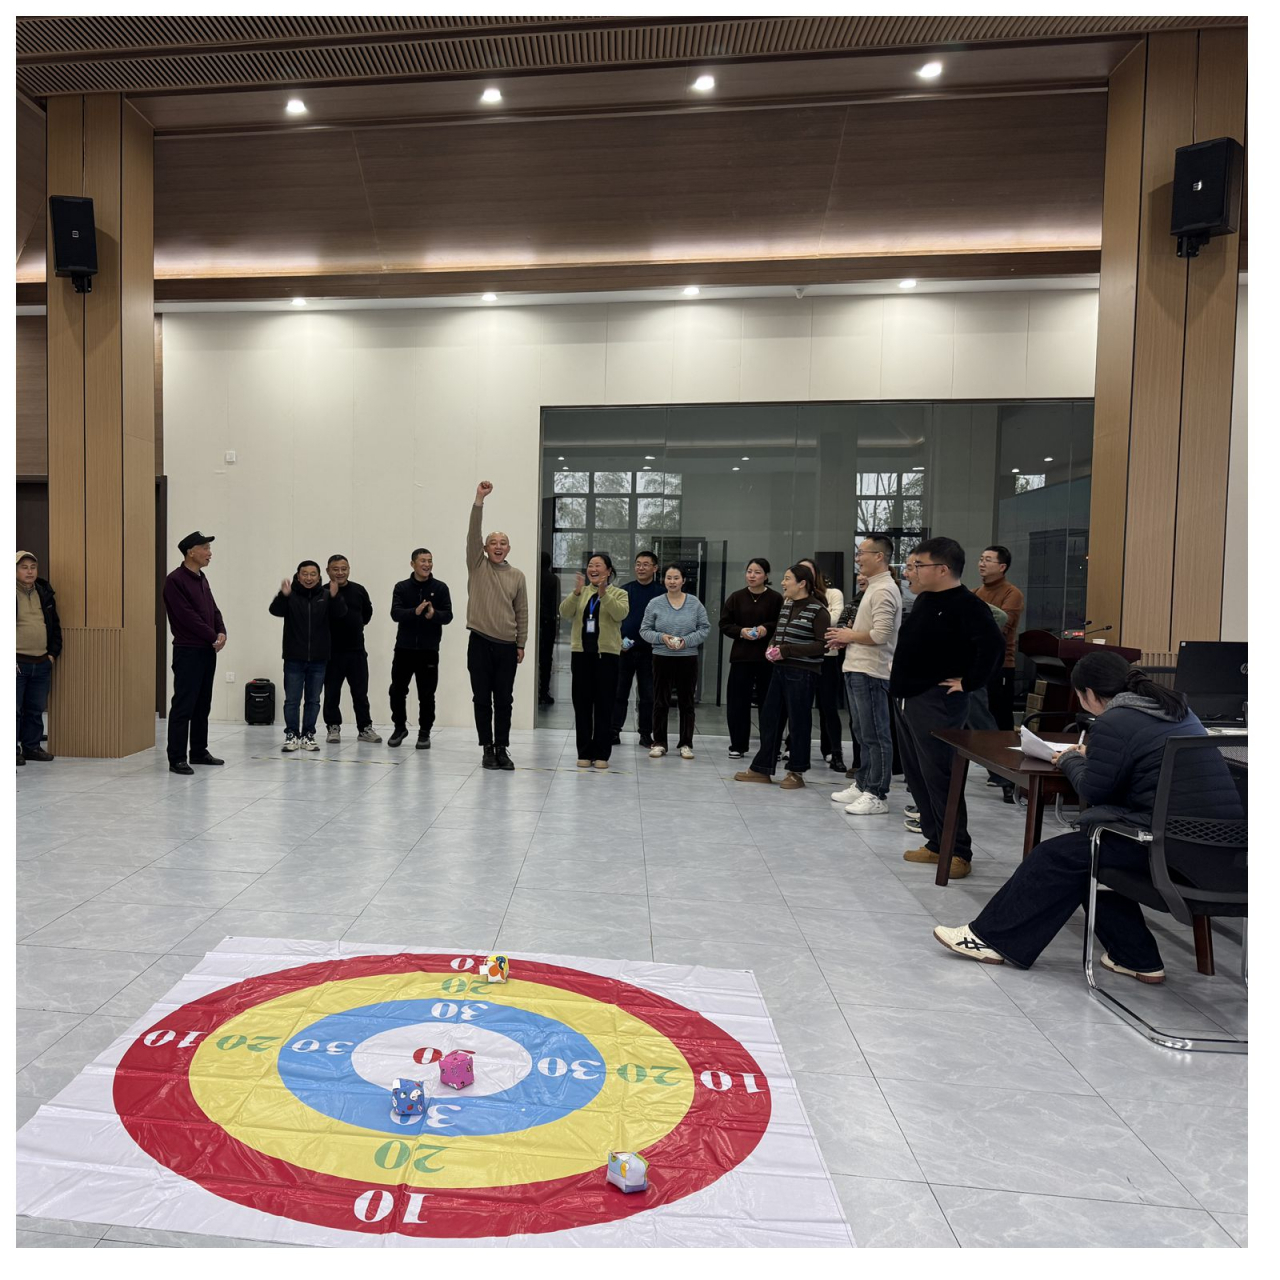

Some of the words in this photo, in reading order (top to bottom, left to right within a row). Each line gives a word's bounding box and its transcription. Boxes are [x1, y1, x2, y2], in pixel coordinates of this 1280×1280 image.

[450, 957, 475, 971] 0
[442, 977, 493, 995] 20
[431, 1002, 489, 1021] 30
[143, 1029, 208, 1049] 10
[216, 1034, 282, 1053] 20
[291, 1038, 354, 1055] 30
[537, 1057, 601, 1080] 30
[616, 1062, 682, 1087] 20
[700, 1070, 766, 1094] 10
[374, 1140, 450, 1173] 20
[353, 1190, 435, 1223] 10
